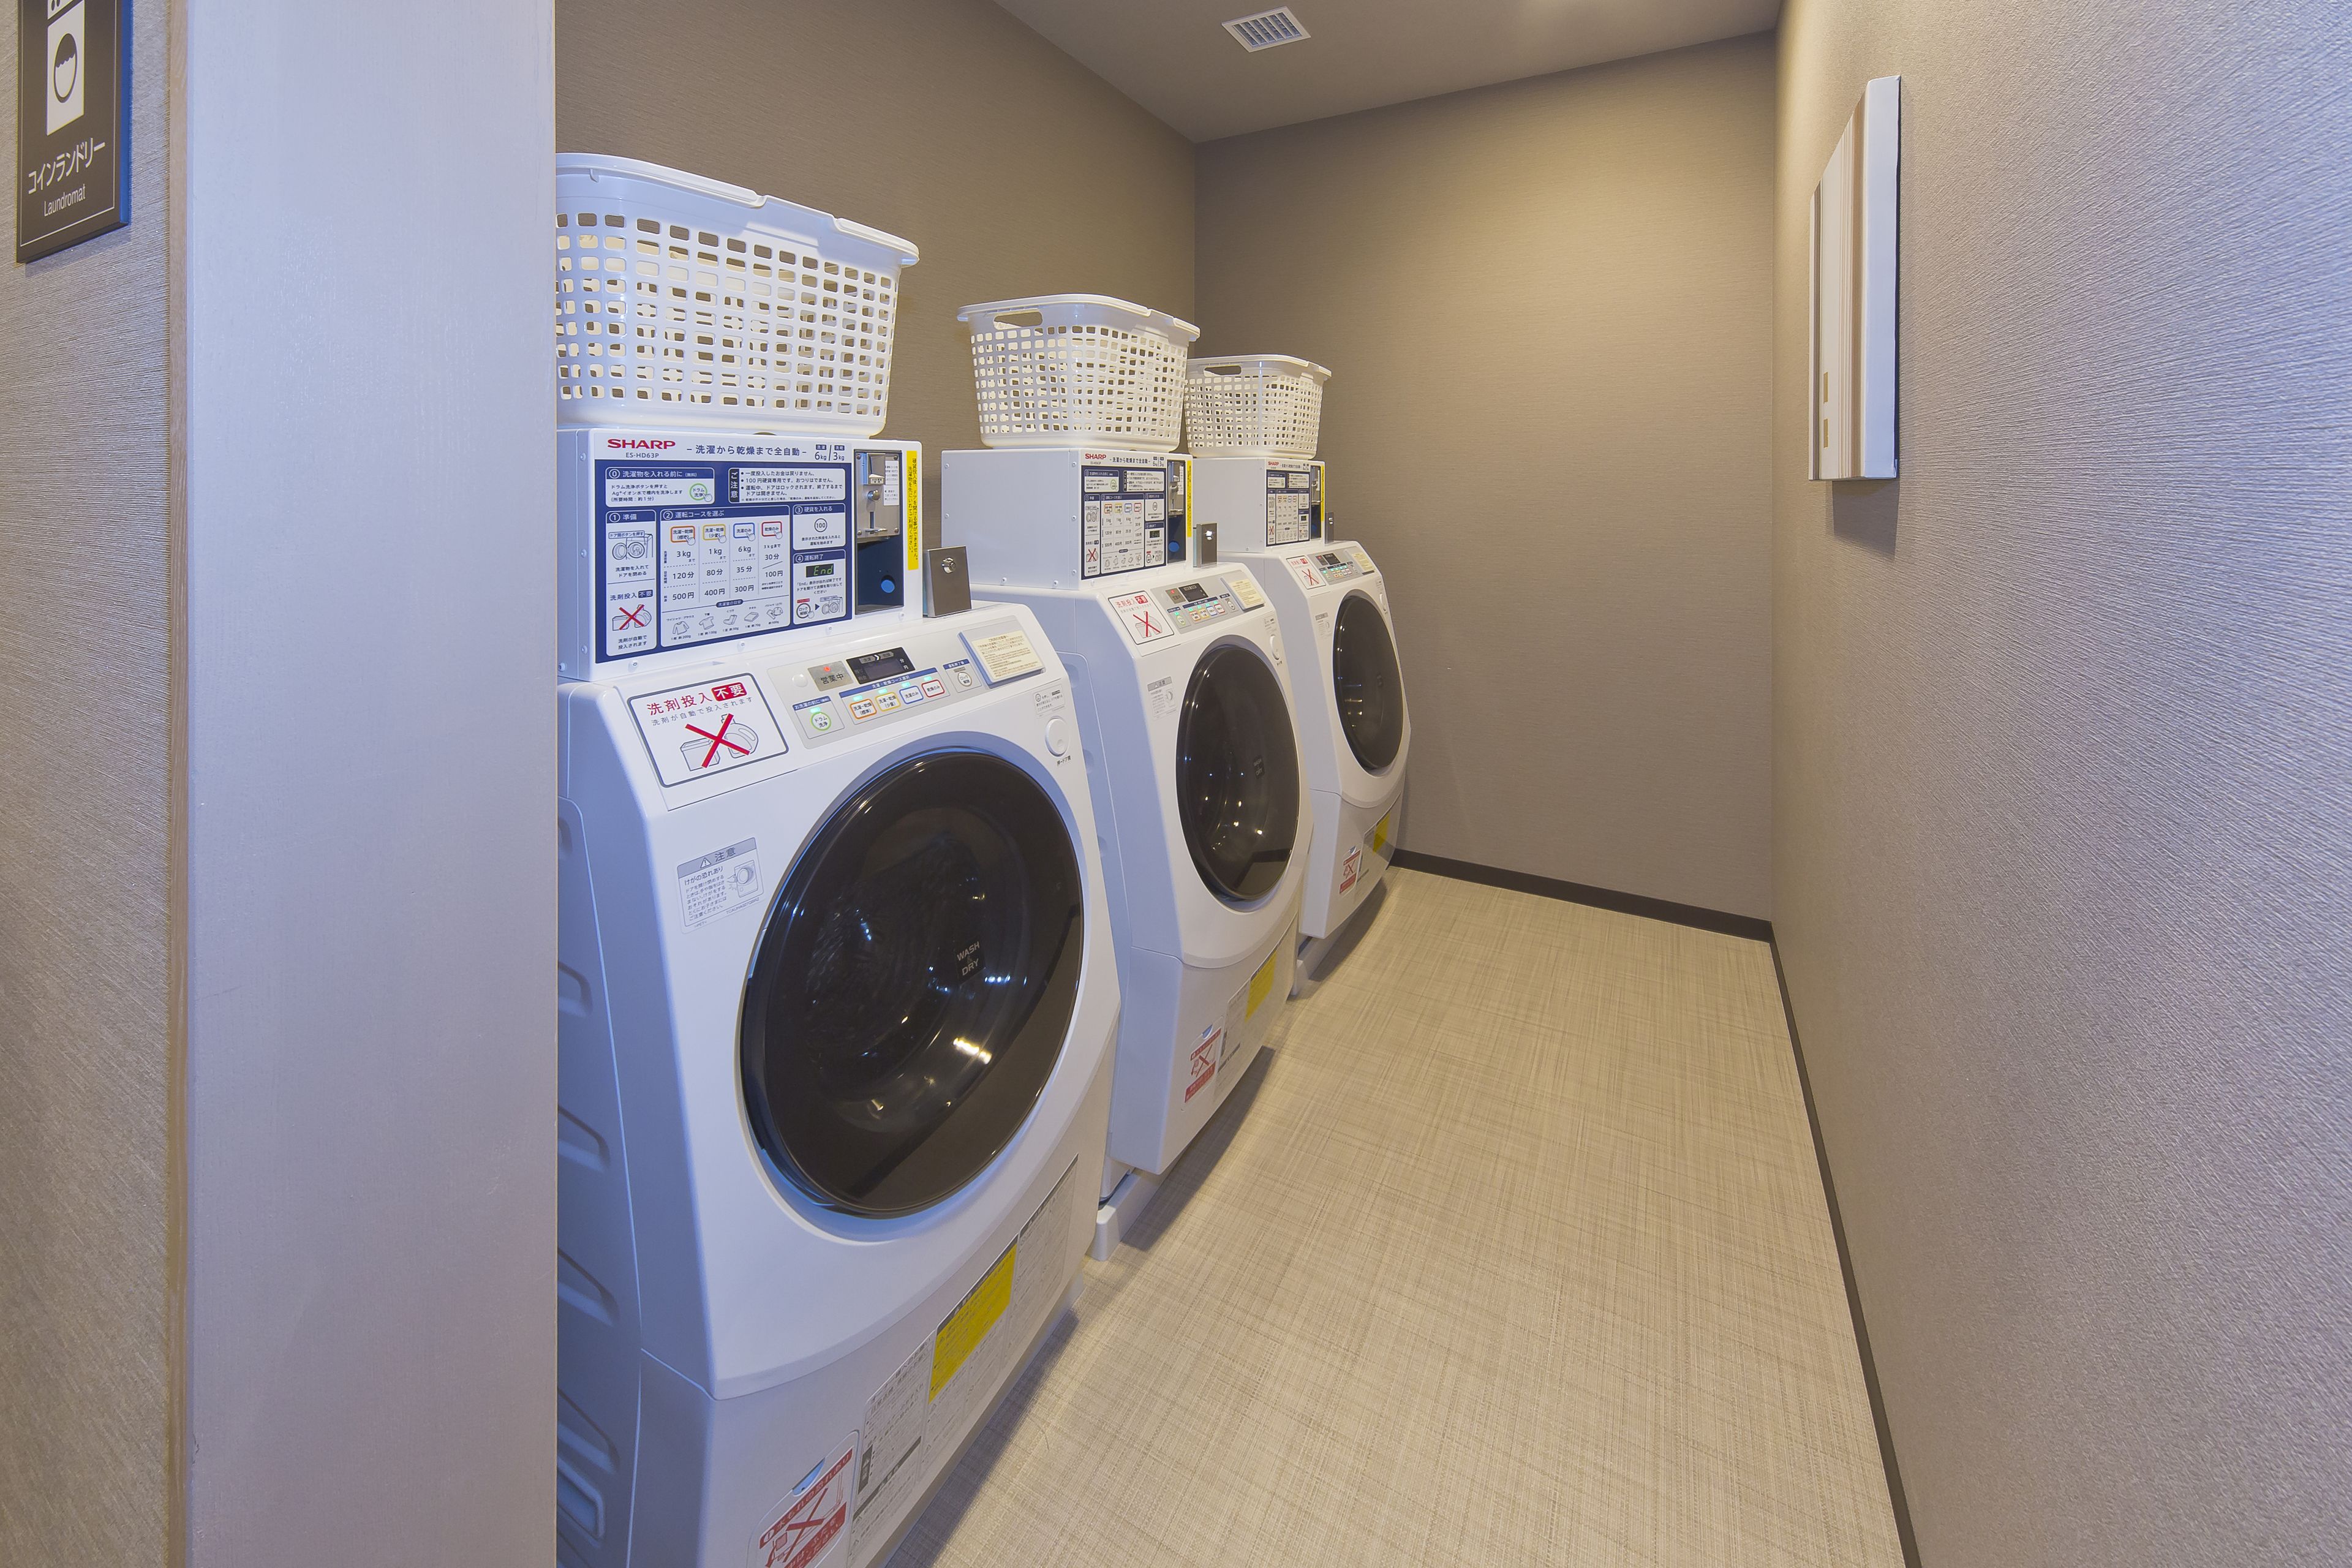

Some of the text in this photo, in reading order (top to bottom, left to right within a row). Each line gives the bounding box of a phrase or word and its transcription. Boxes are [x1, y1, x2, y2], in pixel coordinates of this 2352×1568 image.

[28, 138, 105, 194] コインランドリー
[44, 184, 86, 217] Laundromat
[608, 439, 676, 449] SHARP
[815, 451, 845, 461] 6kg 3kg
[813, 565, 833, 576] End
[610, 592, 637, 601] 洗剤投入
[673, 592, 694, 600] 500円
[821, 673, 844, 685] 営業中
[647, 683, 745, 716] 洗剤投入 不要
[651, 696, 753, 726] 洗剤が自動で投入されます
[715, 846, 736, 862] 注意
[684, 865, 723, 886] けがの恐れあり
[957, 941, 980, 961] WASH
[962, 958, 979, 976] DRY
